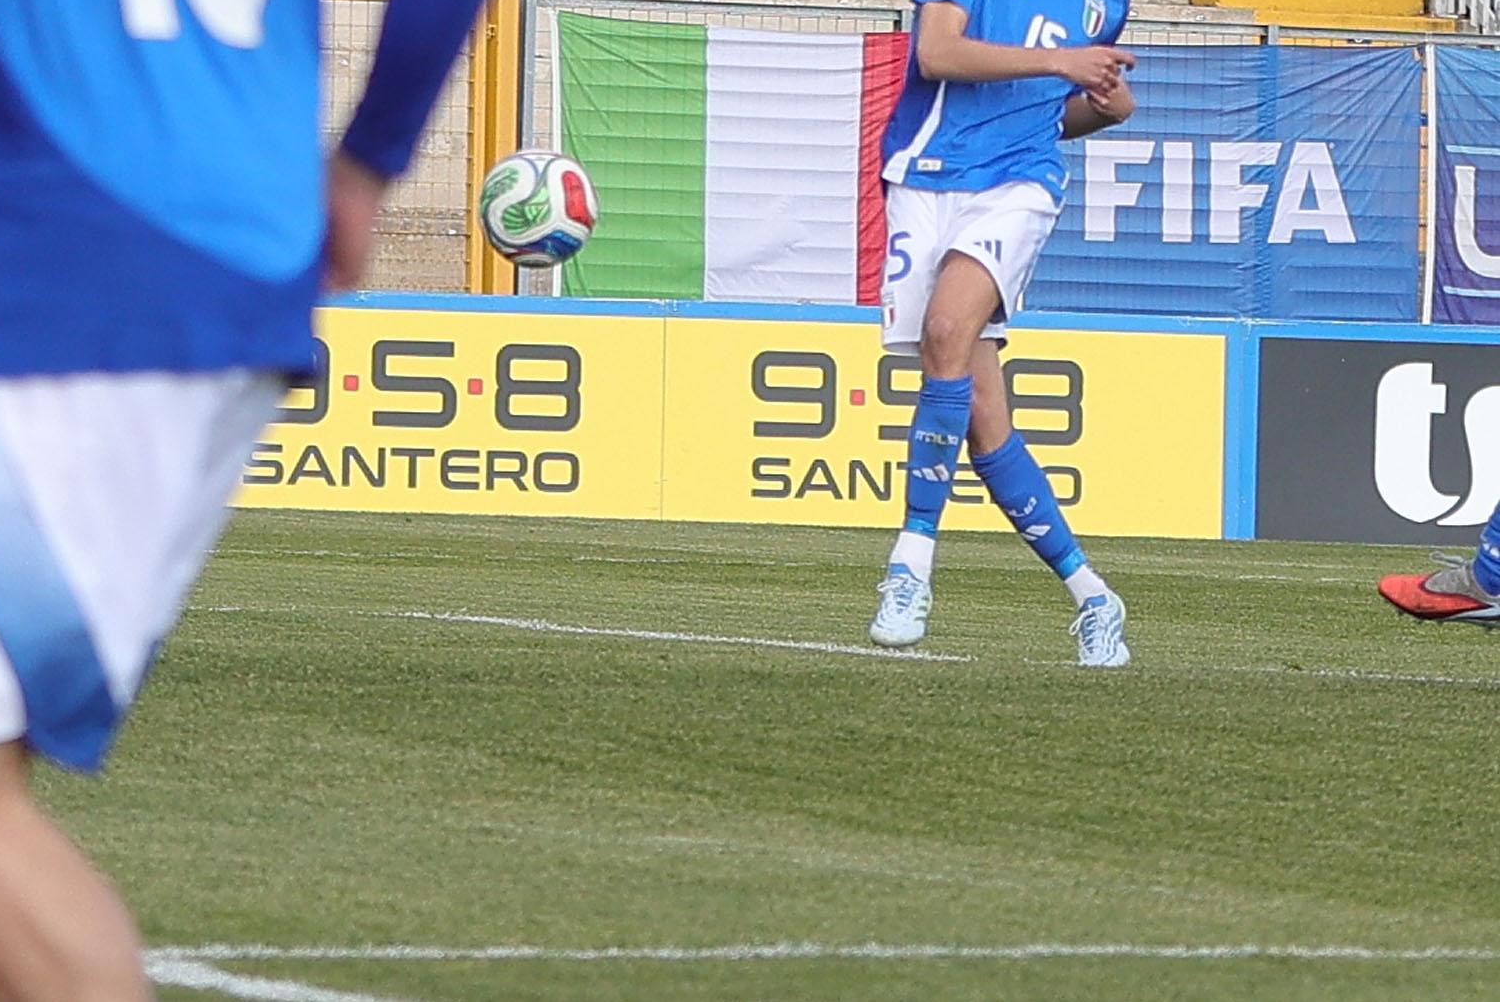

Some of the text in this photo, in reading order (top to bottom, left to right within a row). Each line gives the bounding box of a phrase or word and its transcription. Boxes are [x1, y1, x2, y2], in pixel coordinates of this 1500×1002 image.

[1084, 140, 1357, 244] FIFA
[243, 444, 580, 493] SANTERO
[751, 457, 1083, 507] SANEO
